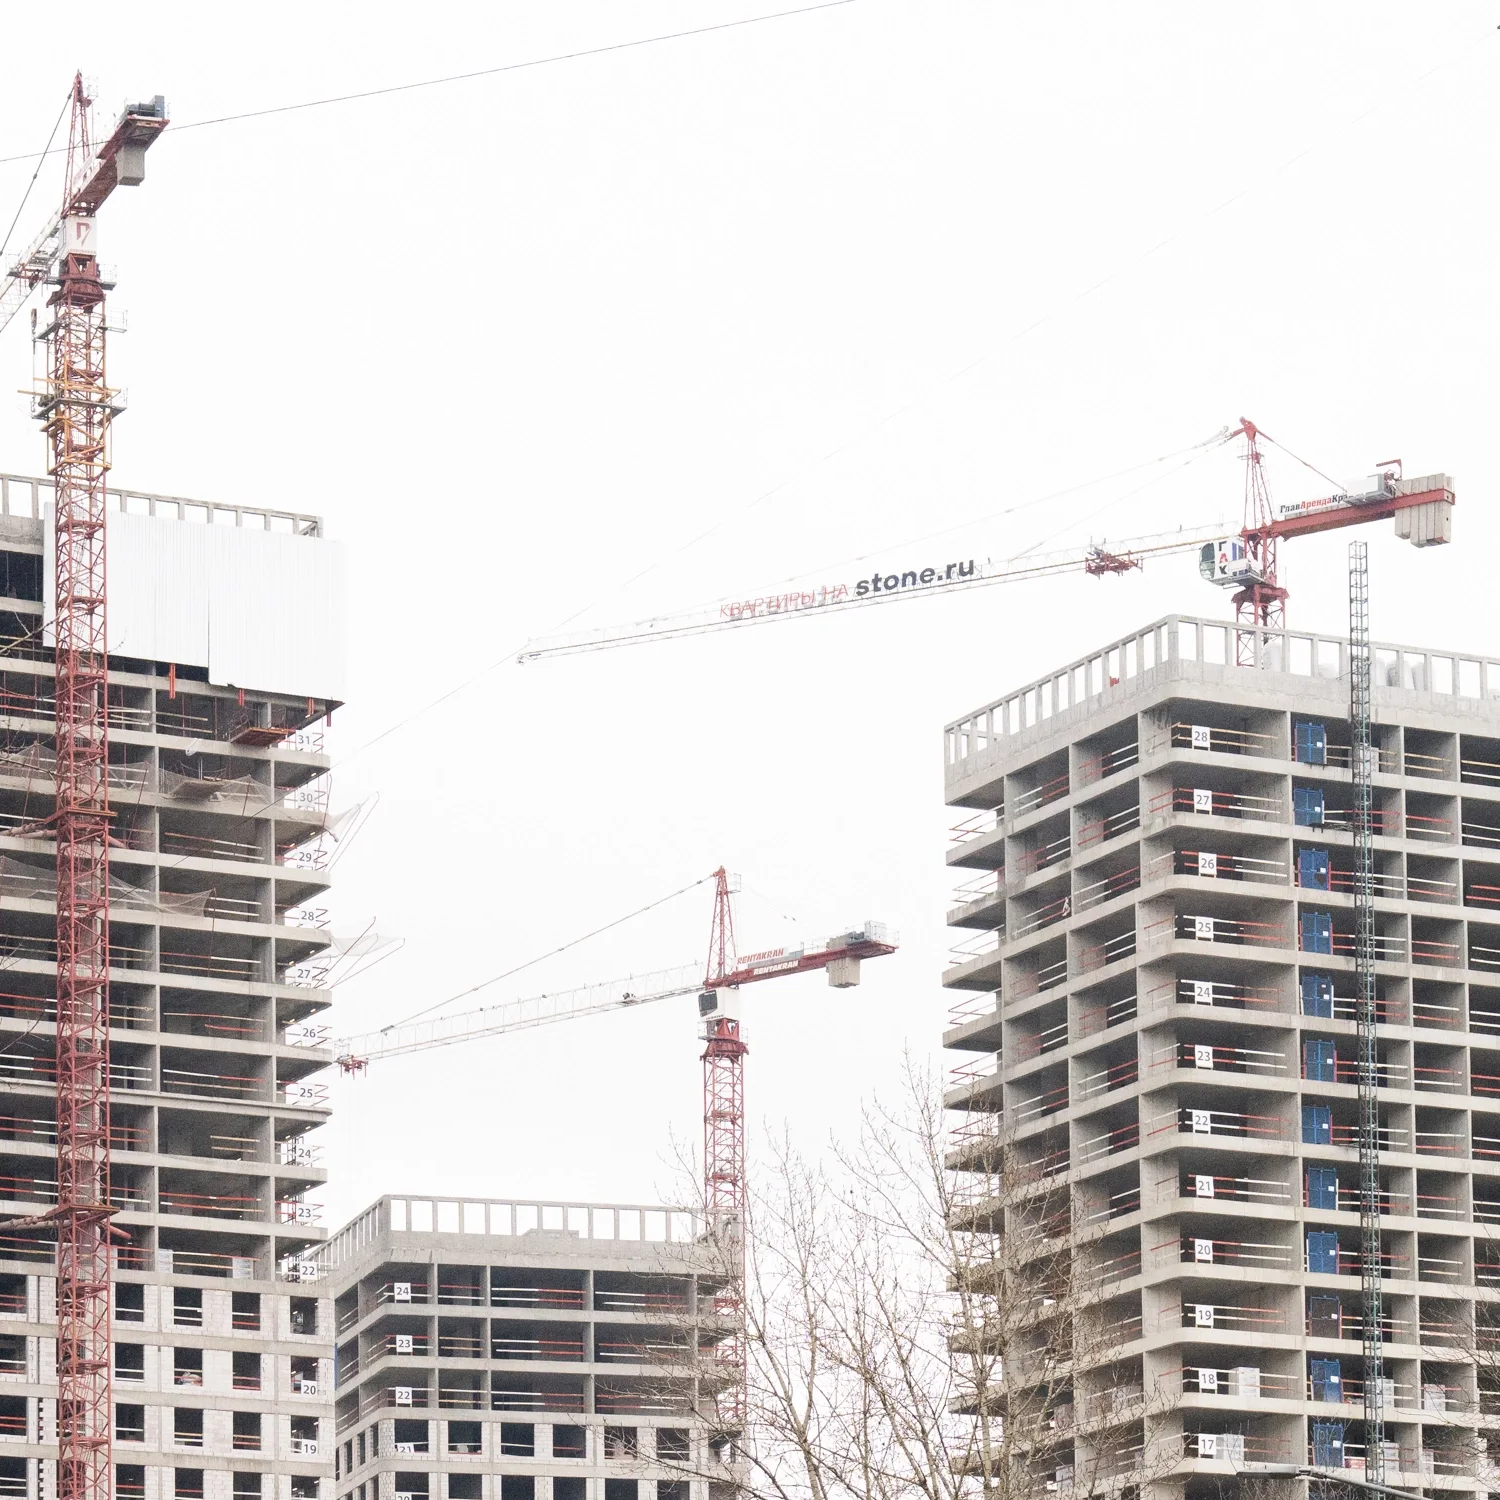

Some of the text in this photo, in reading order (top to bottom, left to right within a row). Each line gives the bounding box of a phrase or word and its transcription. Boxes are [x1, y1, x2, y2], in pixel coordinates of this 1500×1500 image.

[719, 559, 975, 618] КВАРТИРЫ НА stone.ru
[298, 735, 310, 744] 31
[1195, 731, 1208, 741] 28
[300, 793, 312, 802] 30
[1197, 795, 1209, 805] 27
[300, 852, 311, 862] 29
[1202, 858, 1214, 869] 26
[302, 911, 314, 920] 28
[1198, 922, 1211, 932] 25
[737, 948, 785, 965] RENTAKRAN
[753, 960, 799, 976] RENTAKRAN
[298, 969, 310, 979] 27
[1197, 987, 1210, 997] 24
[303, 1028, 315, 1037] 26
[1198, 1051, 1210, 1061] 23
[300, 1088, 312, 1098] 25
[1195, 1115, 1208, 1125] 22
[299, 1149, 311, 1158] 24
[1199, 1181, 1210, 1191] 21
[299, 1208, 311, 1217] 23
[1198, 1245, 1210, 1255] 20
[302, 1266, 315, 1275] 22
[397, 1287, 409, 1295] 24
[1198, 1310, 1211, 1320] 19
[399, 1339, 410, 1347] 23
[1202, 1374, 1214, 1384] 18
[304, 1385, 316, 1394] 20
[398, 1391, 410, 1399] 22
[305, 1444, 316, 1454] 19
[1202, 1440, 1214, 1449] 17
